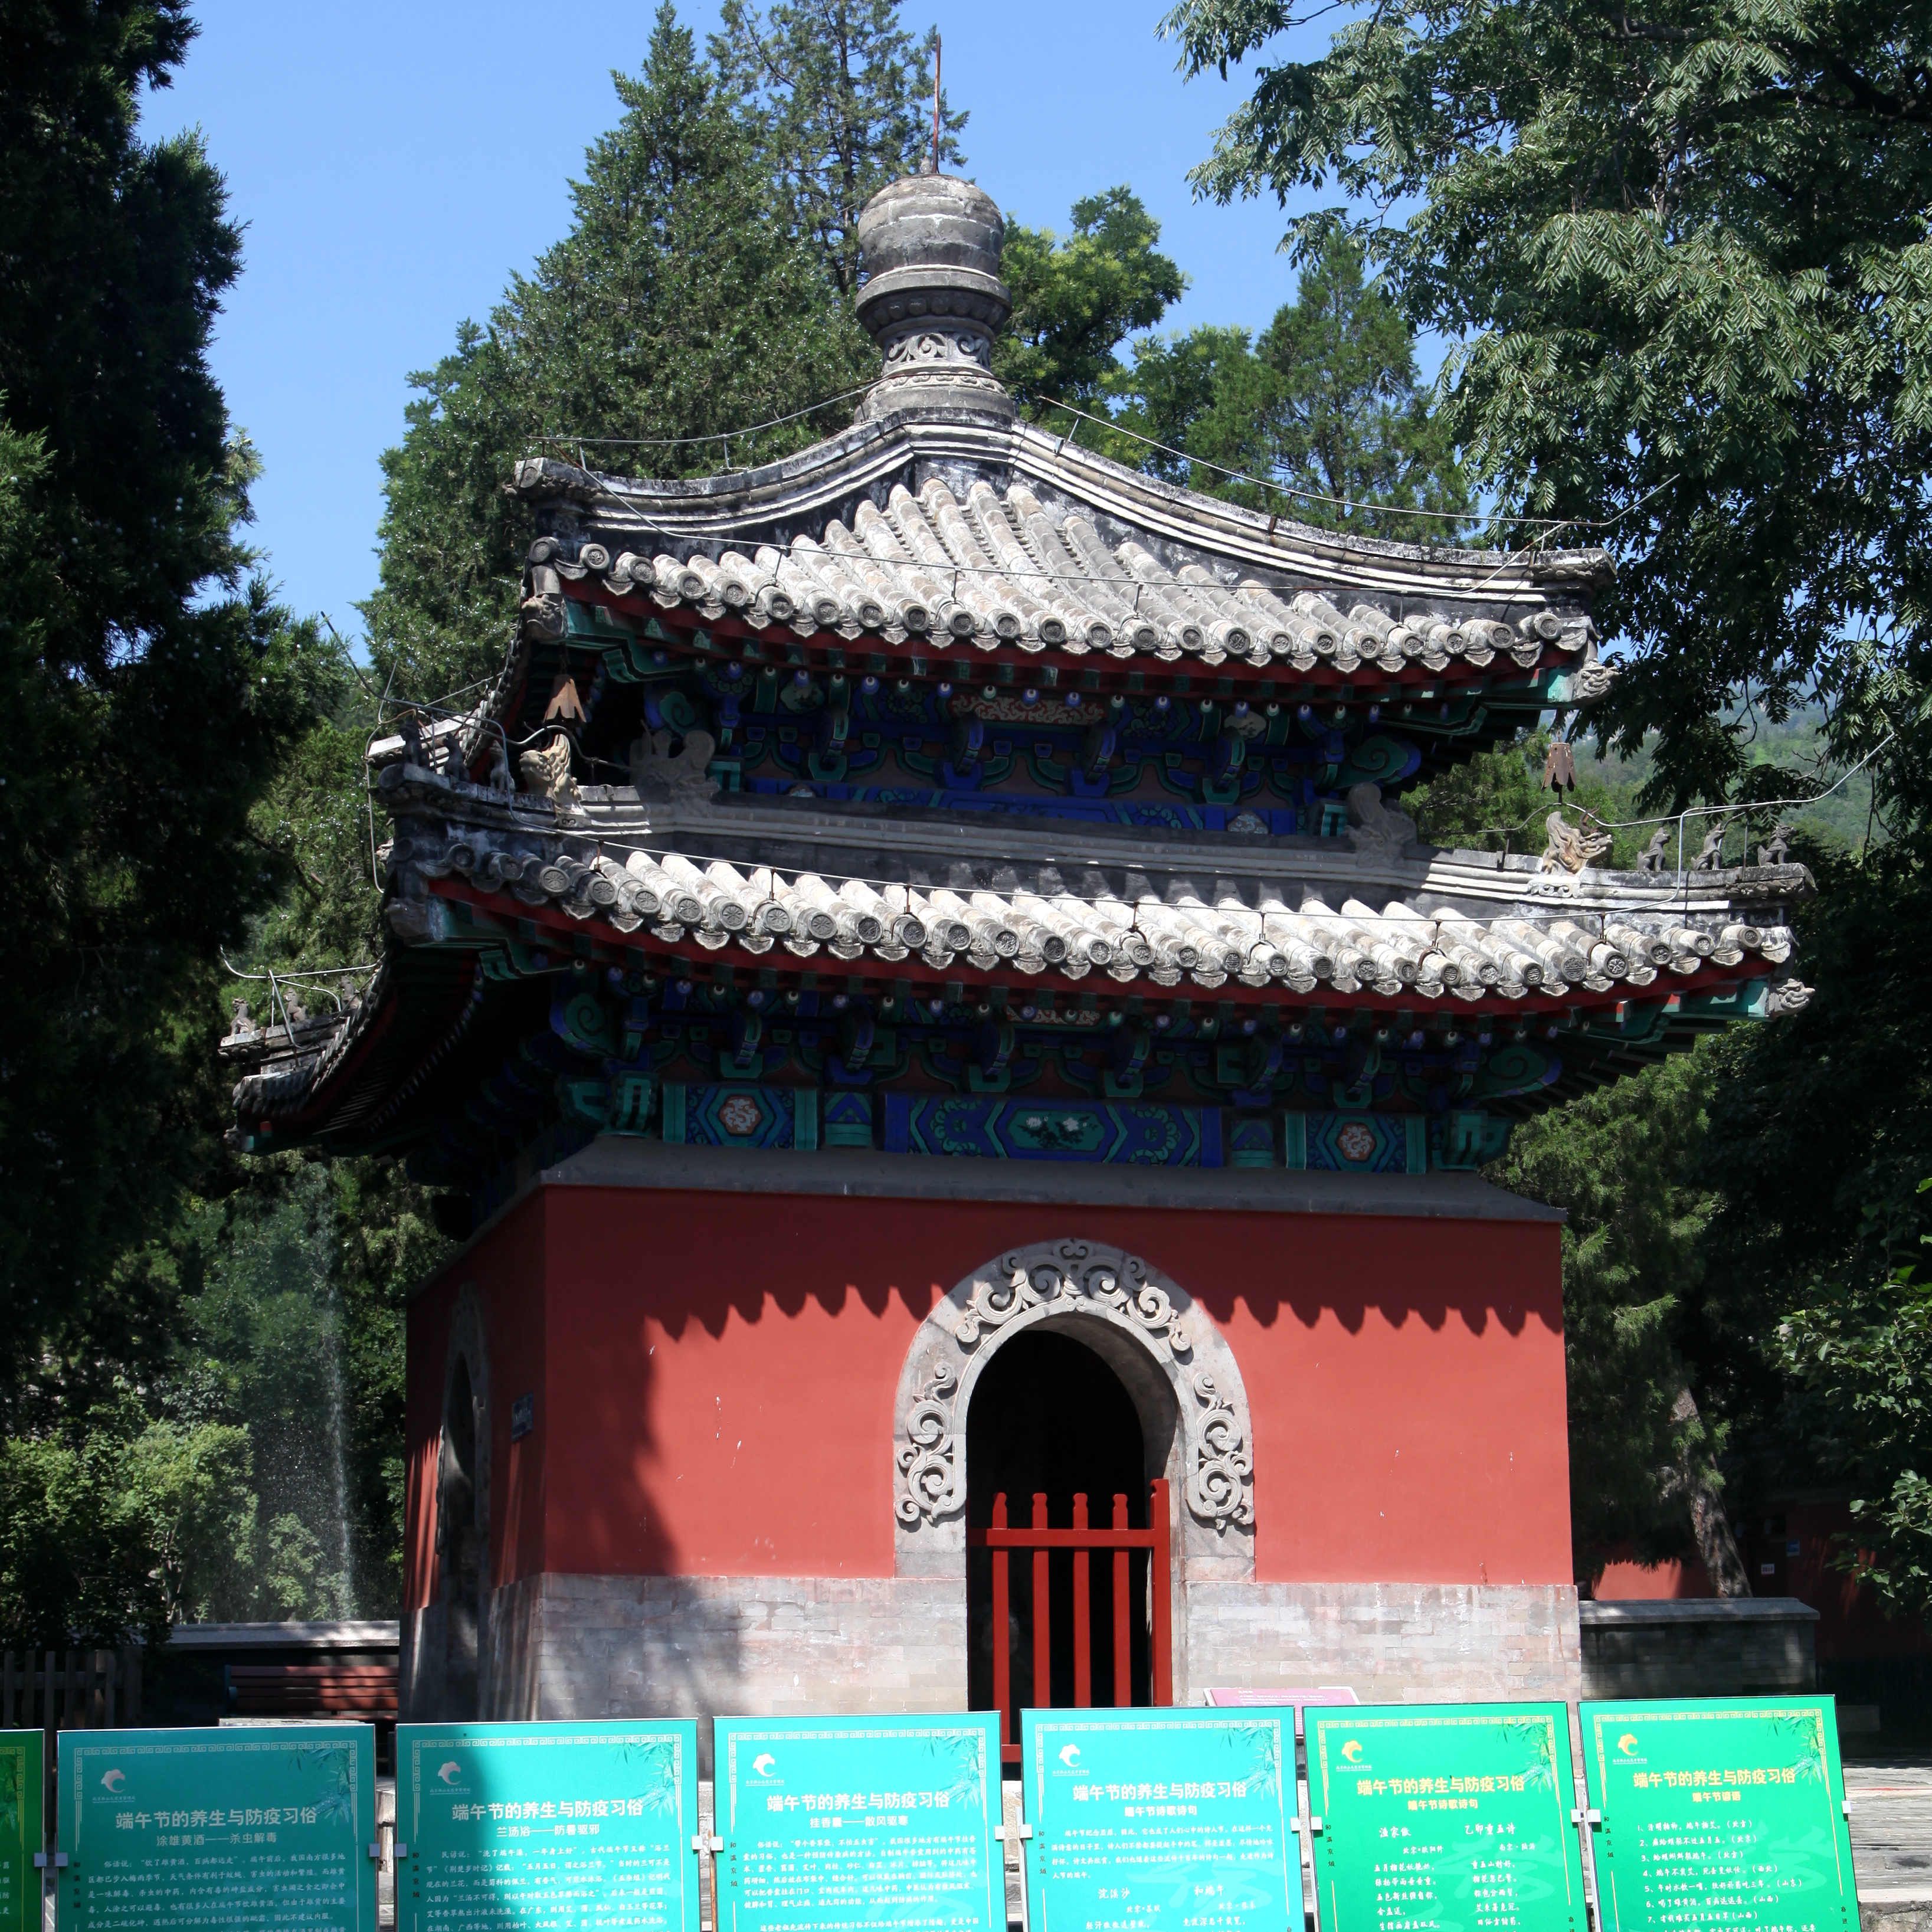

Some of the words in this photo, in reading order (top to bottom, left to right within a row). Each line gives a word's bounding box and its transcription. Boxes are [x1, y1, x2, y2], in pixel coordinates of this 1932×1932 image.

[1633, 1767, 1796, 1787] 端午节的养生与防疫习俗
[1073, 1781, 1247, 1800] 端午节的养生与防疫习俗
[1357, 1774, 1525, 1795] 端午节的养生与防疫习俗
[767, 1791, 949, 1812] 端午节的养生与防疫习俗
[1692, 1791, 1741, 1802] 端午节谚语
[452, 1799, 643, 1820] 端午节的养生与防疫习俗
[1125, 1805, 1197, 1817] 端午节诗歌诗句
[1407, 1799, 1478, 1810] 端午节诗歌诗句
[116, 1807, 317, 1829] 端午节的养生与防疫习俗
[810, 1815, 908, 1828] 挂香囊——散风驱寒
[496, 1824, 600, 1837] 兰汤浴——防暑驱邪
[1465, 1822, 1515, 1835] 乙卯重五诗
[157, 1832, 277, 1846] 涂雄黄酒——杀虫解毒
